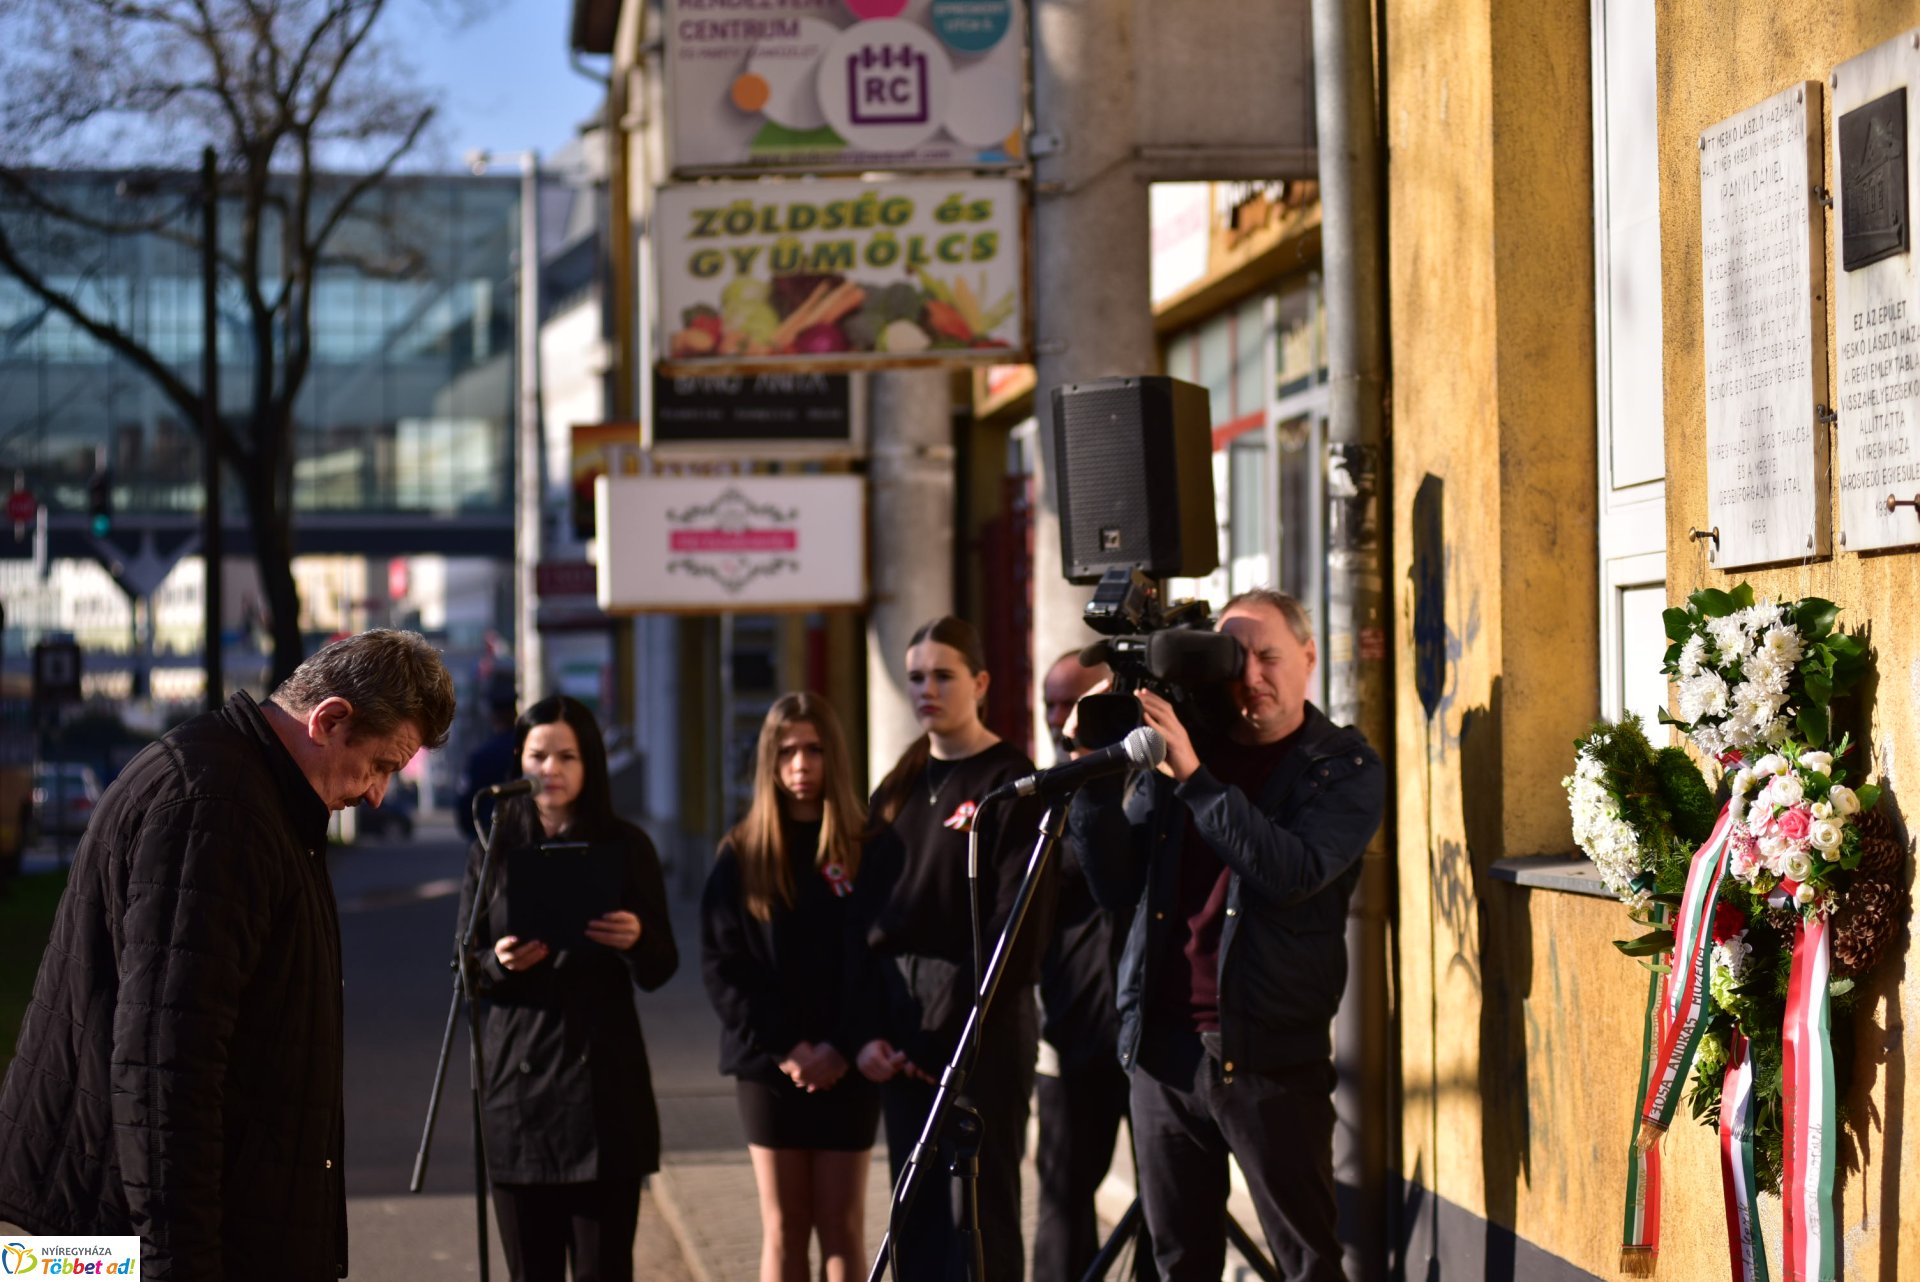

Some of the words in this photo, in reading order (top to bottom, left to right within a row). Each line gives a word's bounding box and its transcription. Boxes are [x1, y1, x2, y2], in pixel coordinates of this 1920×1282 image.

[679, 19, 799, 40] CENTRUM
[865, 77, 911, 103] RC
[686, 190, 914, 238] ZÖLDSÉG
[934, 193, 993, 223] és
[687, 231, 999, 279] GYÜMÖLCS
[1853, 312, 1862, 334] EZ
[1866, 307, 1876, 329] AZ
[1841, 331, 1865, 364] MESKÓ
[1844, 369, 1849, 389] A
